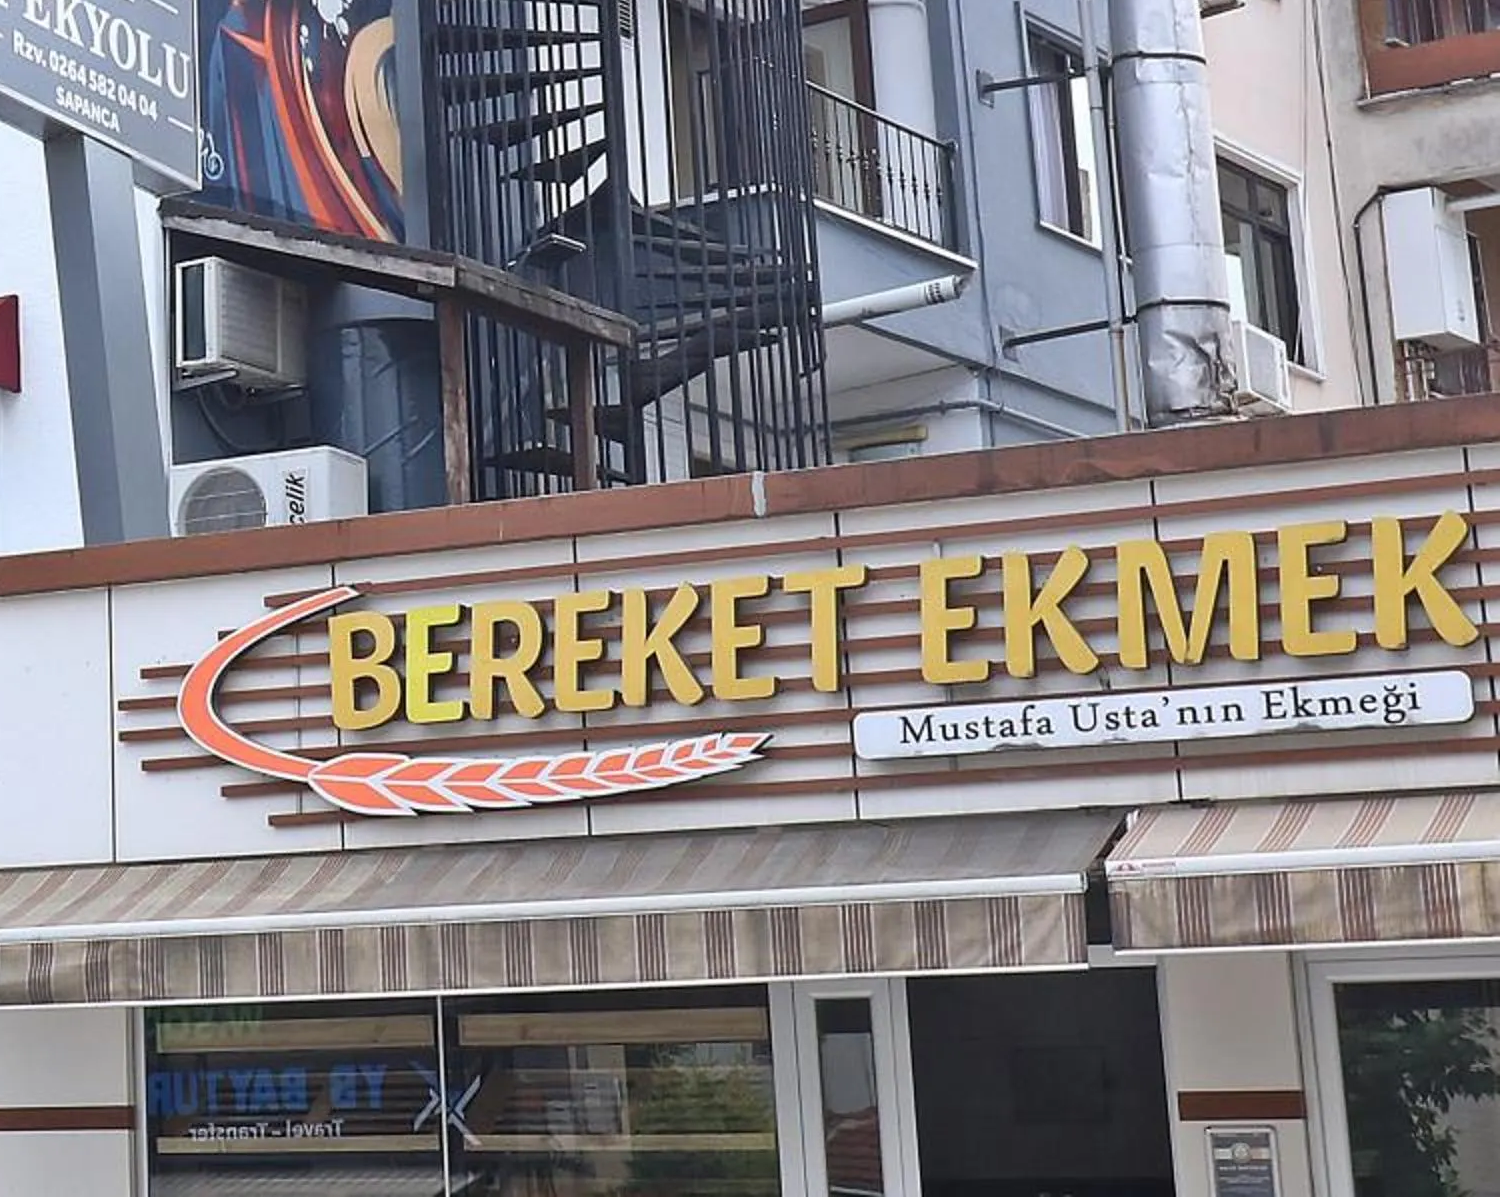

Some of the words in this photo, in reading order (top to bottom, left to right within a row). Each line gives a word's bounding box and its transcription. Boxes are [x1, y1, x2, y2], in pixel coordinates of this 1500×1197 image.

[13, 29, 46, 67] Rzv.
[50, 51, 86, 87] 0264
[88, 69, 116, 102] 582
[117, 84, 137, 111] 04
[139, 94, 158, 122] 04
[56, 86, 121, 134] SAPANCA
[328, 565, 868, 732] BEREKET
[920, 509, 1481, 685] EKMEK
[900, 705, 1056, 744] Mustafa
[1262, 682, 1422, 726] Ekmeği
